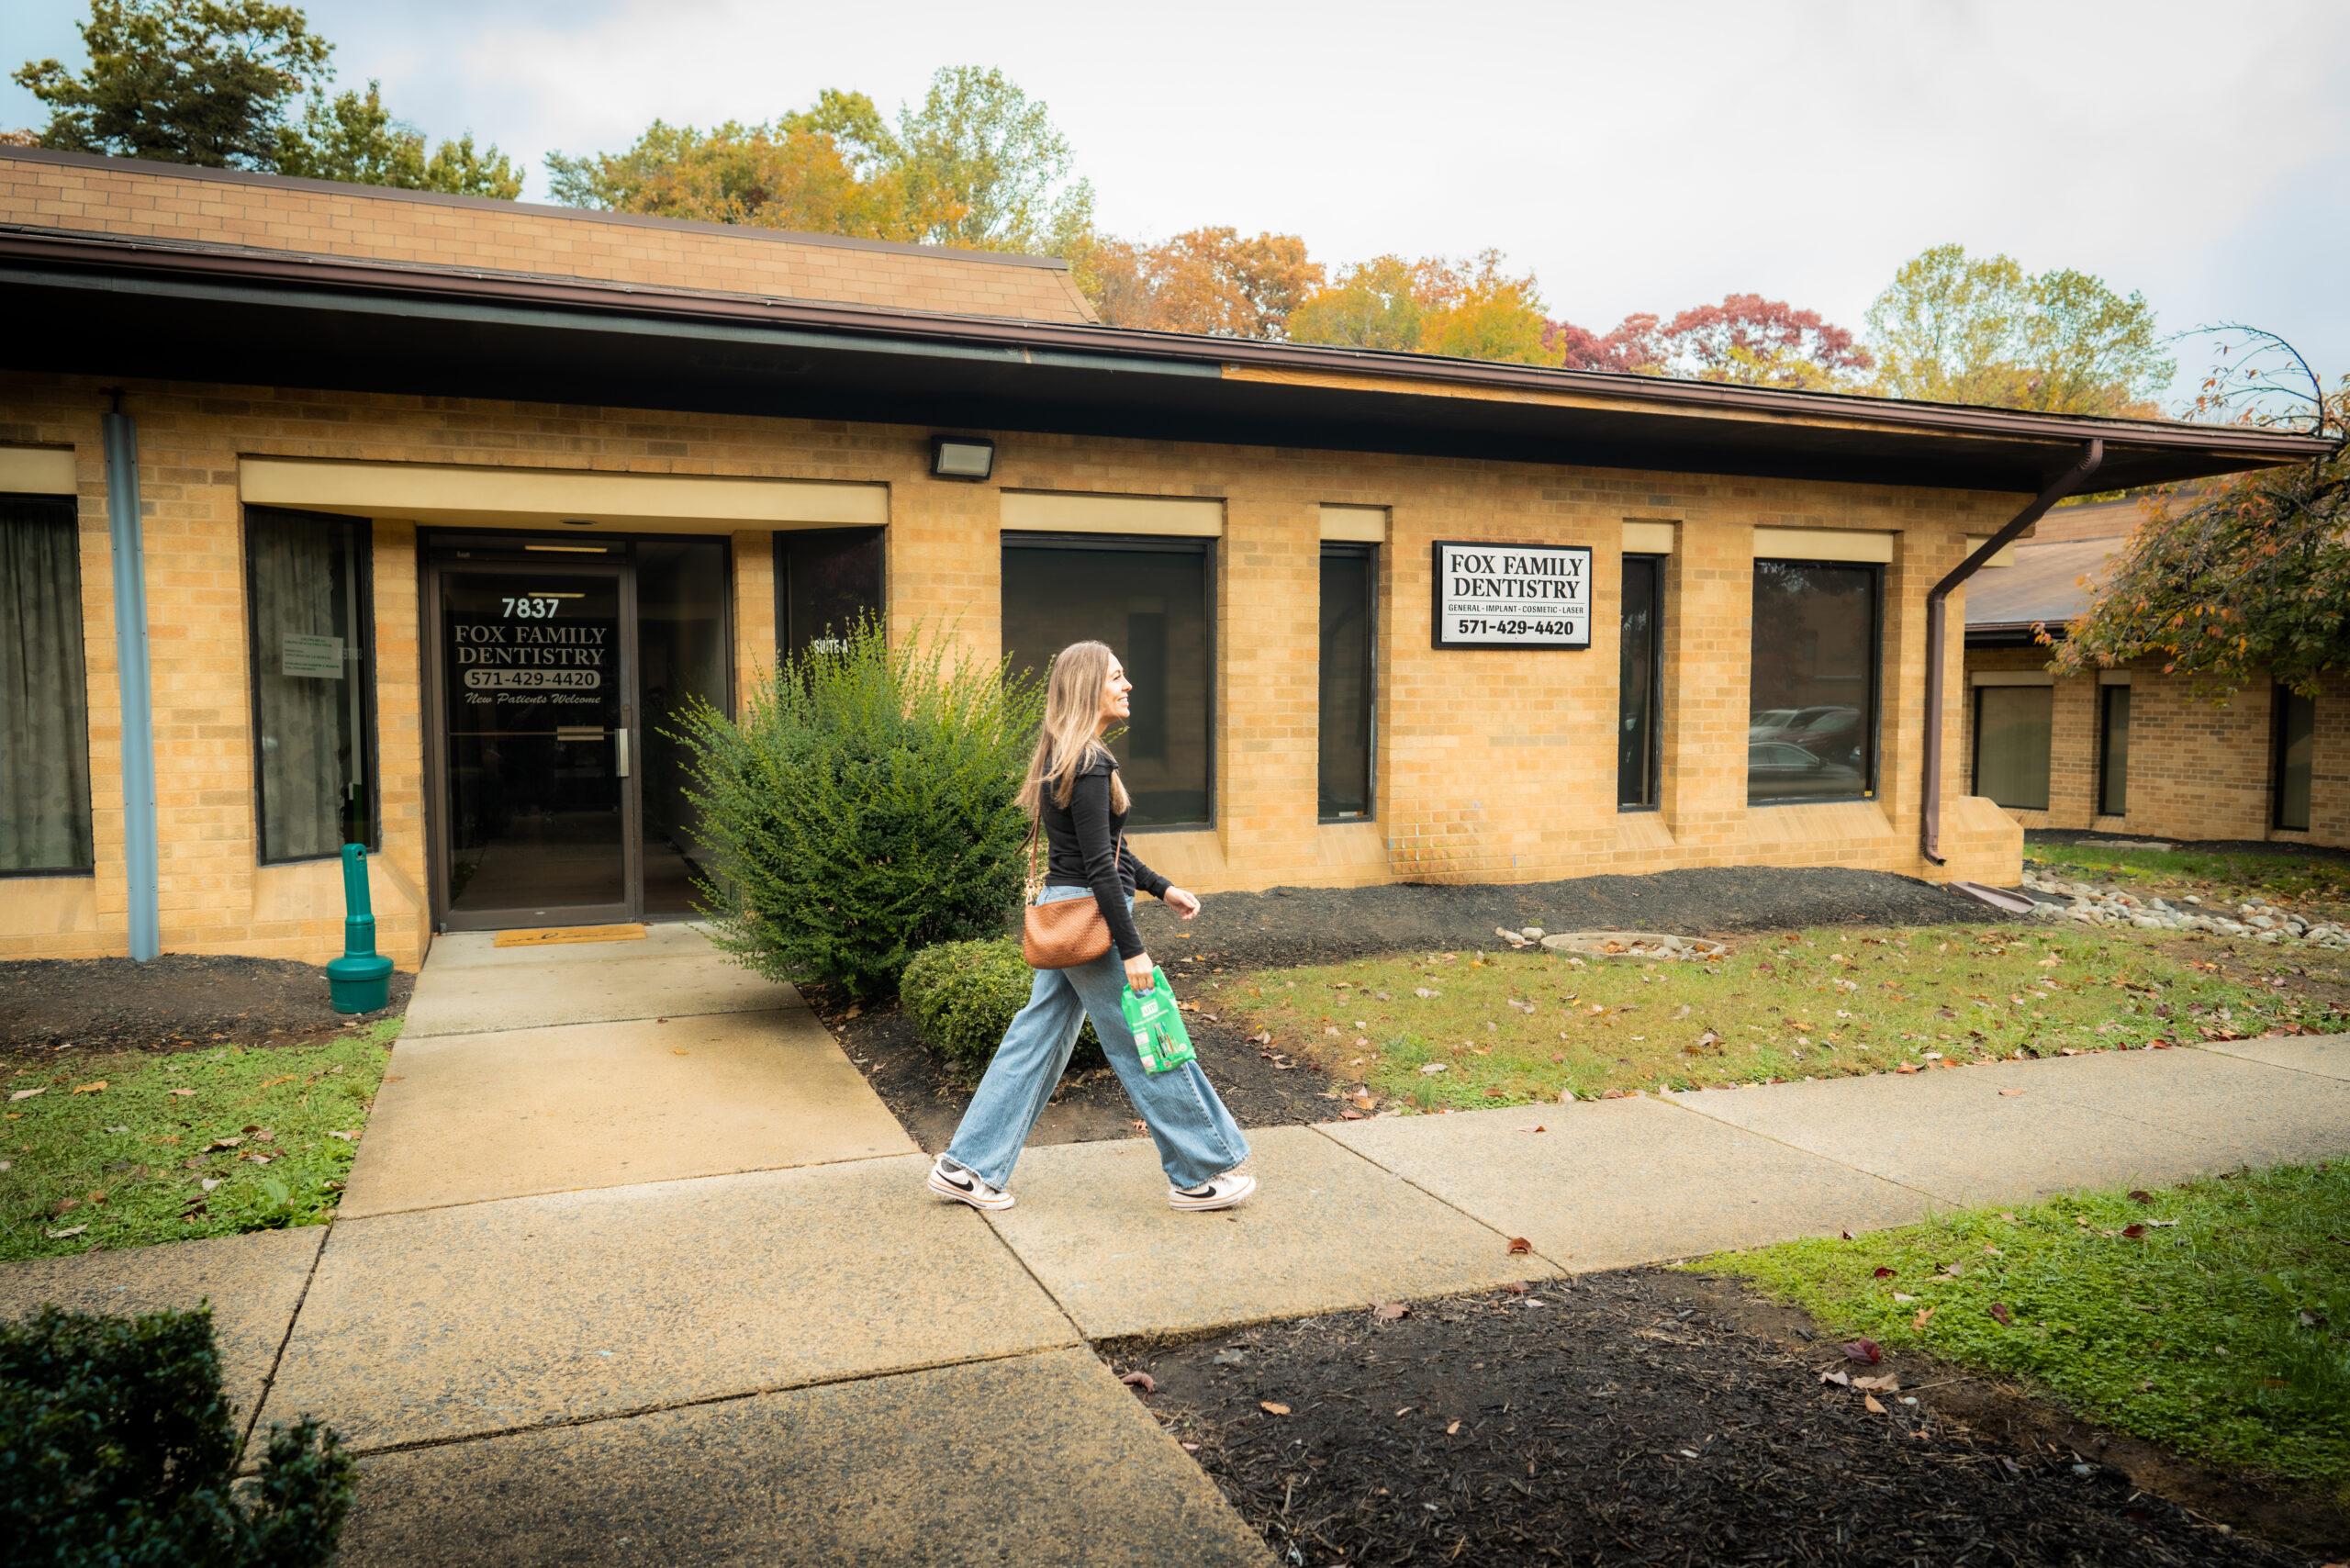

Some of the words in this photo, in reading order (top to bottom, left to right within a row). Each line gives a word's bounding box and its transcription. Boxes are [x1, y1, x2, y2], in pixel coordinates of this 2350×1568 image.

[1450, 554, 1496, 574] FOX
[1503, 555, 1583, 577] FAMILY
[1454, 577, 1580, 599] DENTISTRY
[501, 598, 559, 619] 7837
[1449, 604, 1480, 612] GENERAL
[1485, 604, 1517, 613] IMPLANT
[1522, 605, 1558, 614] COSMETIC
[1562, 606, 1584, 614] LASER
[454, 625, 507, 644] FOX
[515, 626, 608, 644] FAMILY
[1459, 620, 1574, 635] 571-429-4420
[843, 639, 849, 653] A
[457, 646, 606, 666] DENTISTRY
[471, 672, 595, 686] 571-429-4420
[464, 692, 493, 705] New
[497, 692, 548, 705] Patients
[551, 693, 601, 705] Welcome
